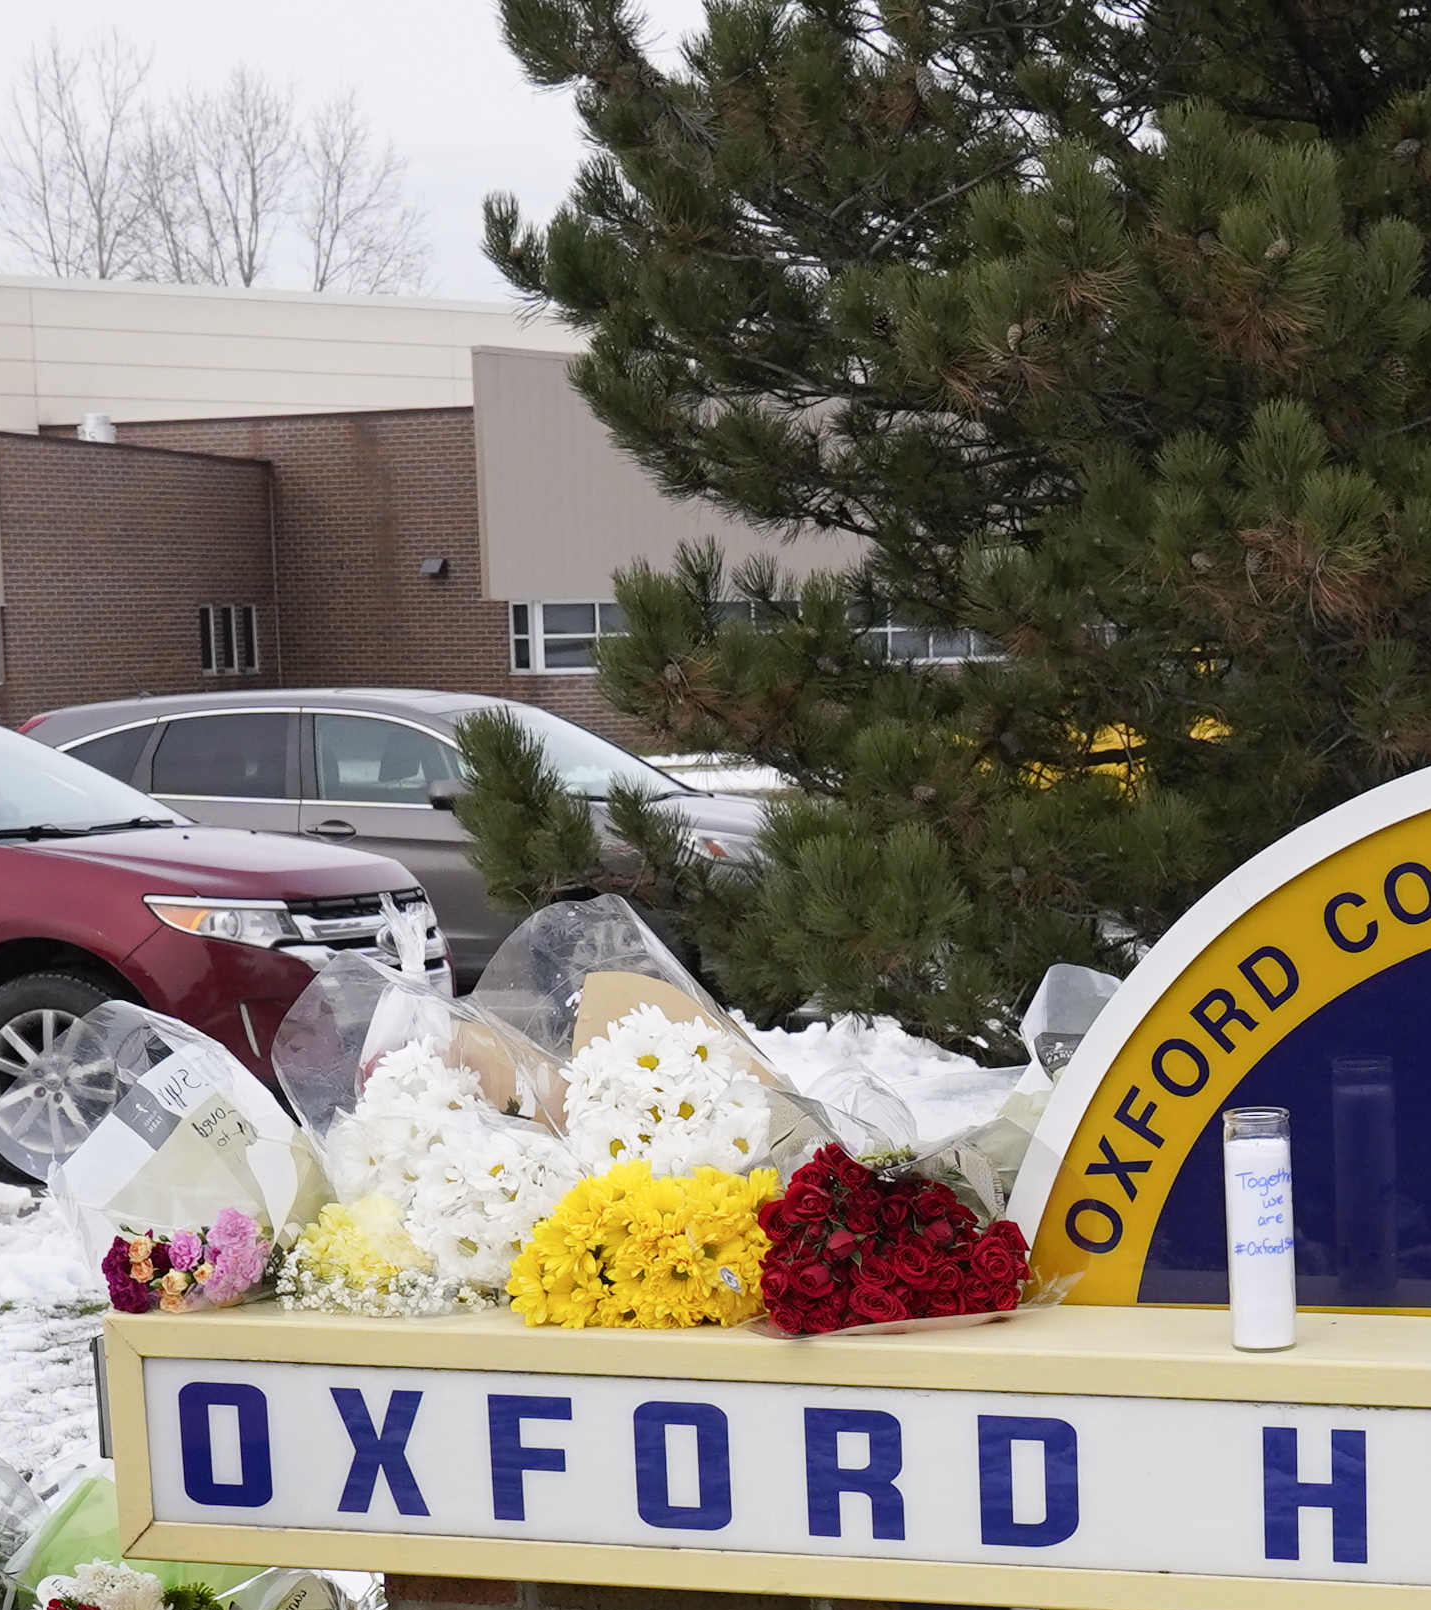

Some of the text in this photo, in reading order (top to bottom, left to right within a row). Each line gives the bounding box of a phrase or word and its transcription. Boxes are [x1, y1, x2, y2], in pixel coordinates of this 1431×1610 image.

[1062, 943, 1302, 1256] OXFORD
[1257, 1212, 1285, 1227] are
[1262, 1194, 1285, 1209] we
[177, 1380, 1081, 1549] OXFORD
